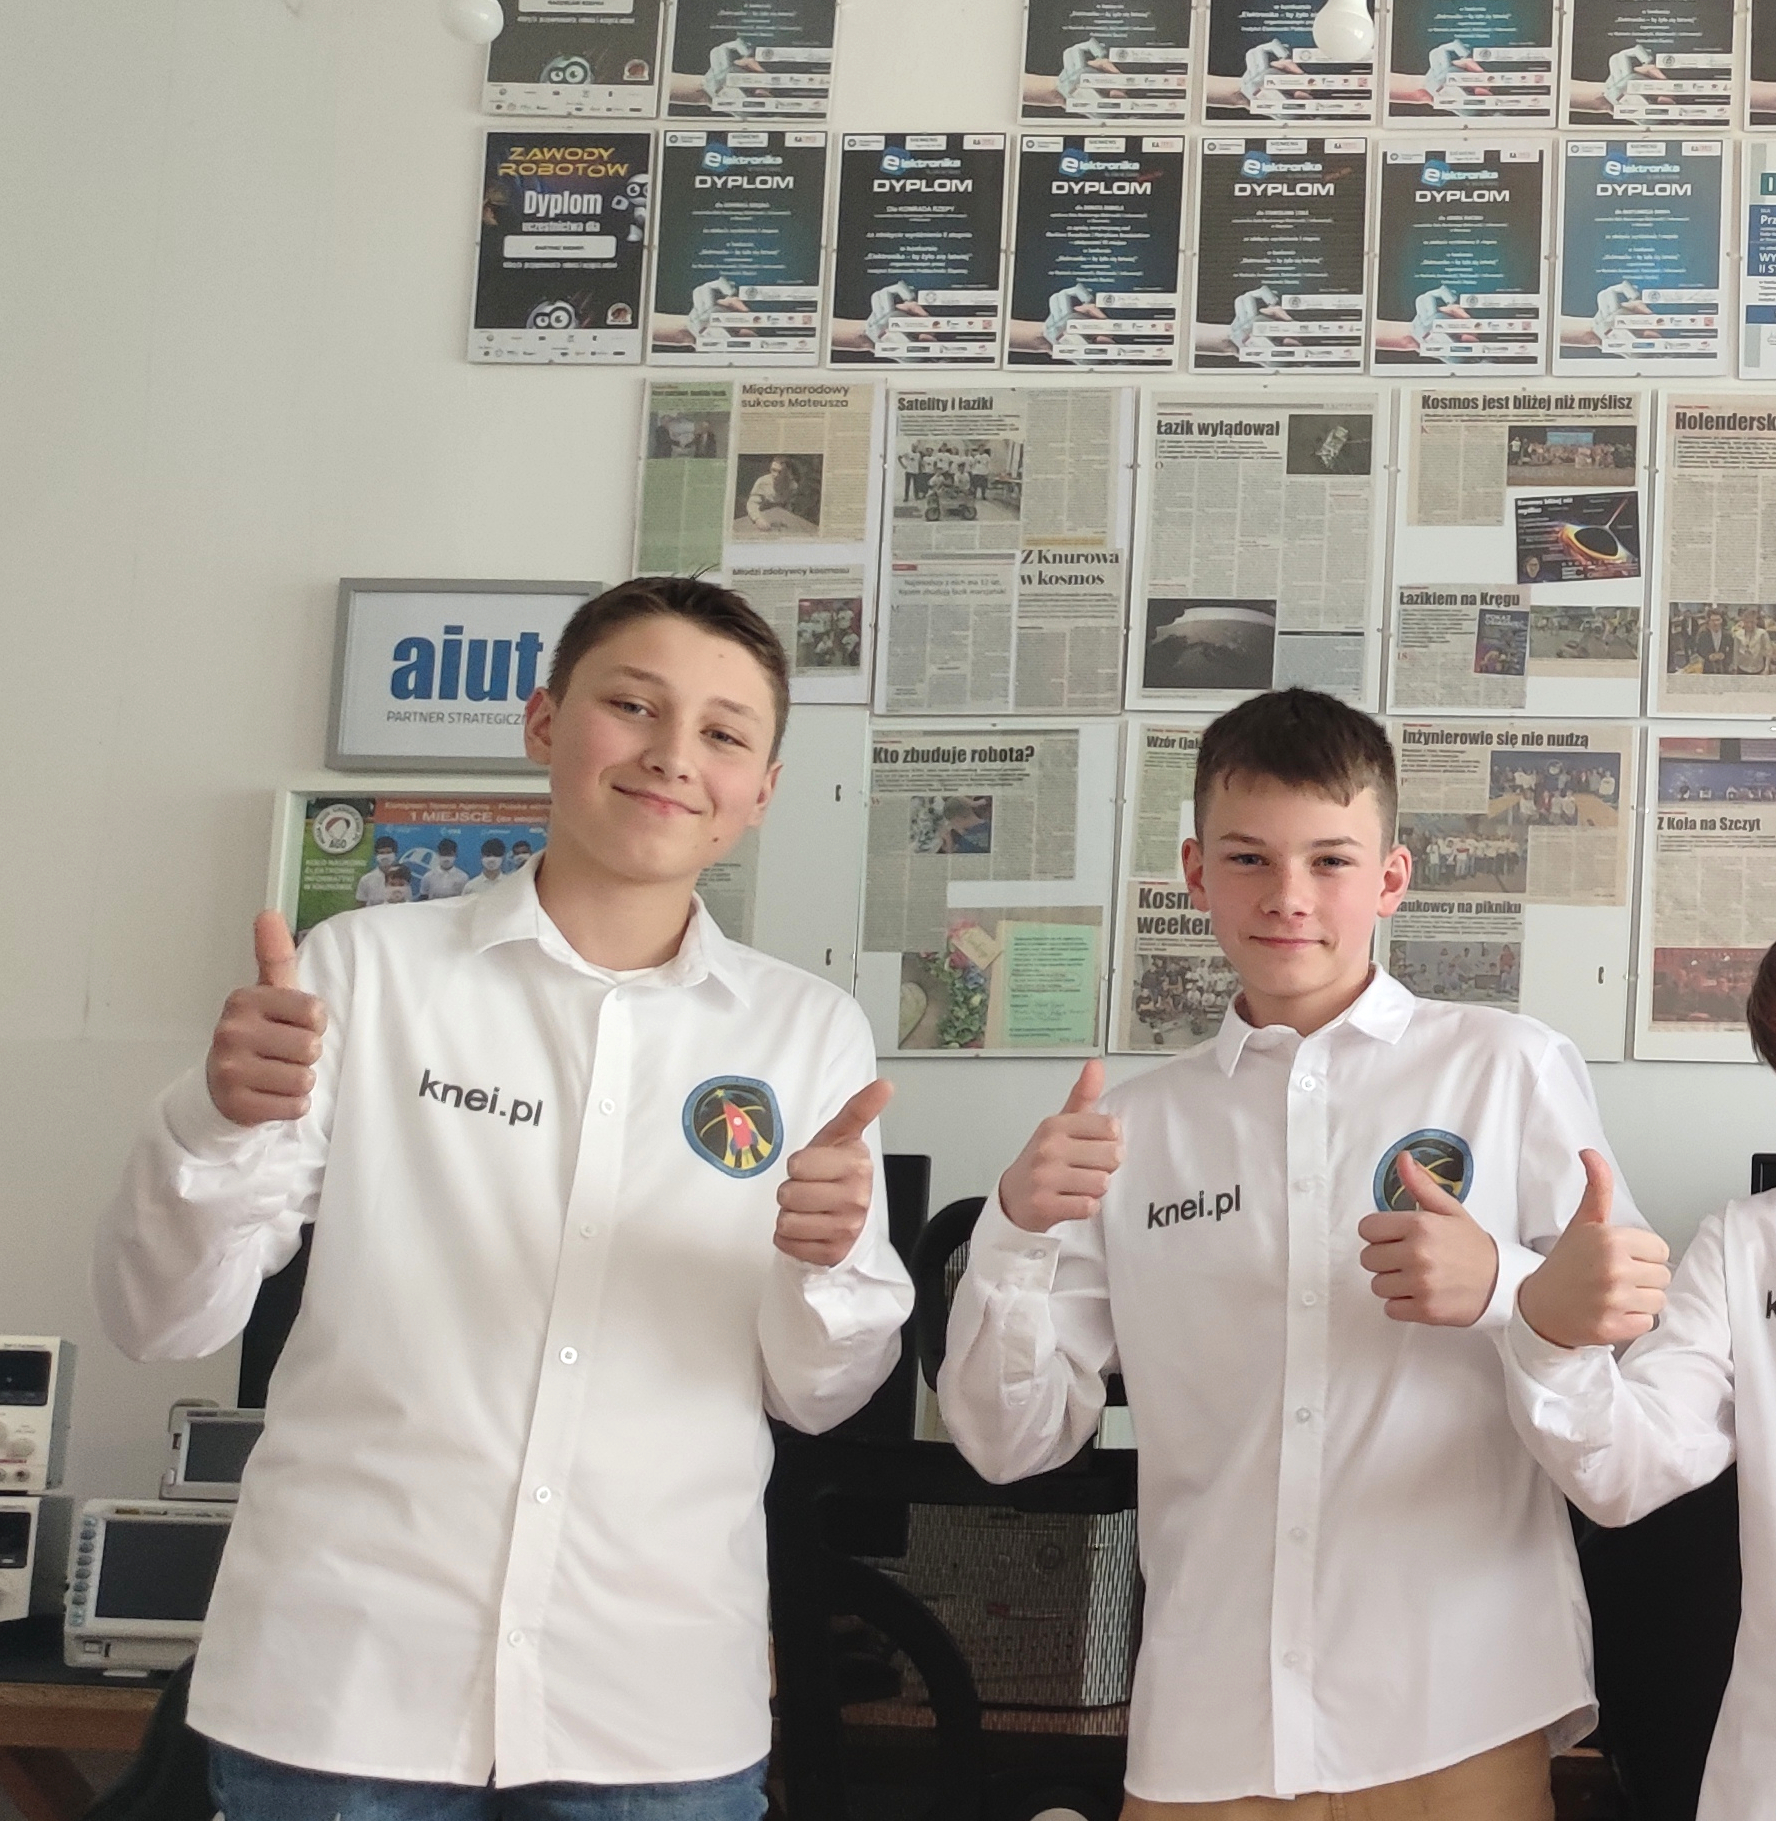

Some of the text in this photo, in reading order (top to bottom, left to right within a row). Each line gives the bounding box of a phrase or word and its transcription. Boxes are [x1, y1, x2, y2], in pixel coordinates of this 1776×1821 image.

[508, 147, 615, 160] ZAWODY
[695, 176, 794, 189] DYPLOM
[873, 179, 973, 193] DYPLOM
[1051, 181, 1151, 195] DYPLOM
[1234, 183, 1335, 196] DYPLOM
[1596, 183, 1692, 196] DYPLOM
[1415, 190, 1510, 202] DYPLOM
[524, 190, 603, 218] Dyplom
[1758, 264, 1766, 274] II
[742, 384, 850, 397] Międzynarodowy
[742, 398, 849, 408] sukces Mateusza
[898, 396, 994, 414] Satelity łaziki
[1422, 394, 1633, 412] Kosmos jest bliżej niż myślisz
[1157, 419, 1280, 438] Łazik wylądował
[1021, 548, 1119, 566] Z Knurowa
[1021, 570, 1104, 586] w kosmos
[1400, 592, 1520, 608] Łazikiem na Kręgu
[390, 625, 544, 701] aiut
[387, 711, 444, 724] PARTNER
[1147, 736, 1176, 749] Wzór
[1402, 730, 1589, 749] Inżynierowie się nie nudzą
[873, 746, 1035, 766] Kto zbuduje robota?
[422, 812, 493, 822] MIEJSCE
[1657, 817, 1664, 831] Z
[1700, 819, 1716, 831] na
[1719, 817, 1762, 832] Szczyt
[1458, 900, 1522, 914] na pikniku
[419, 1068, 544, 1126] knei.pl
[1147, 1185, 1241, 1230] knei.pl
